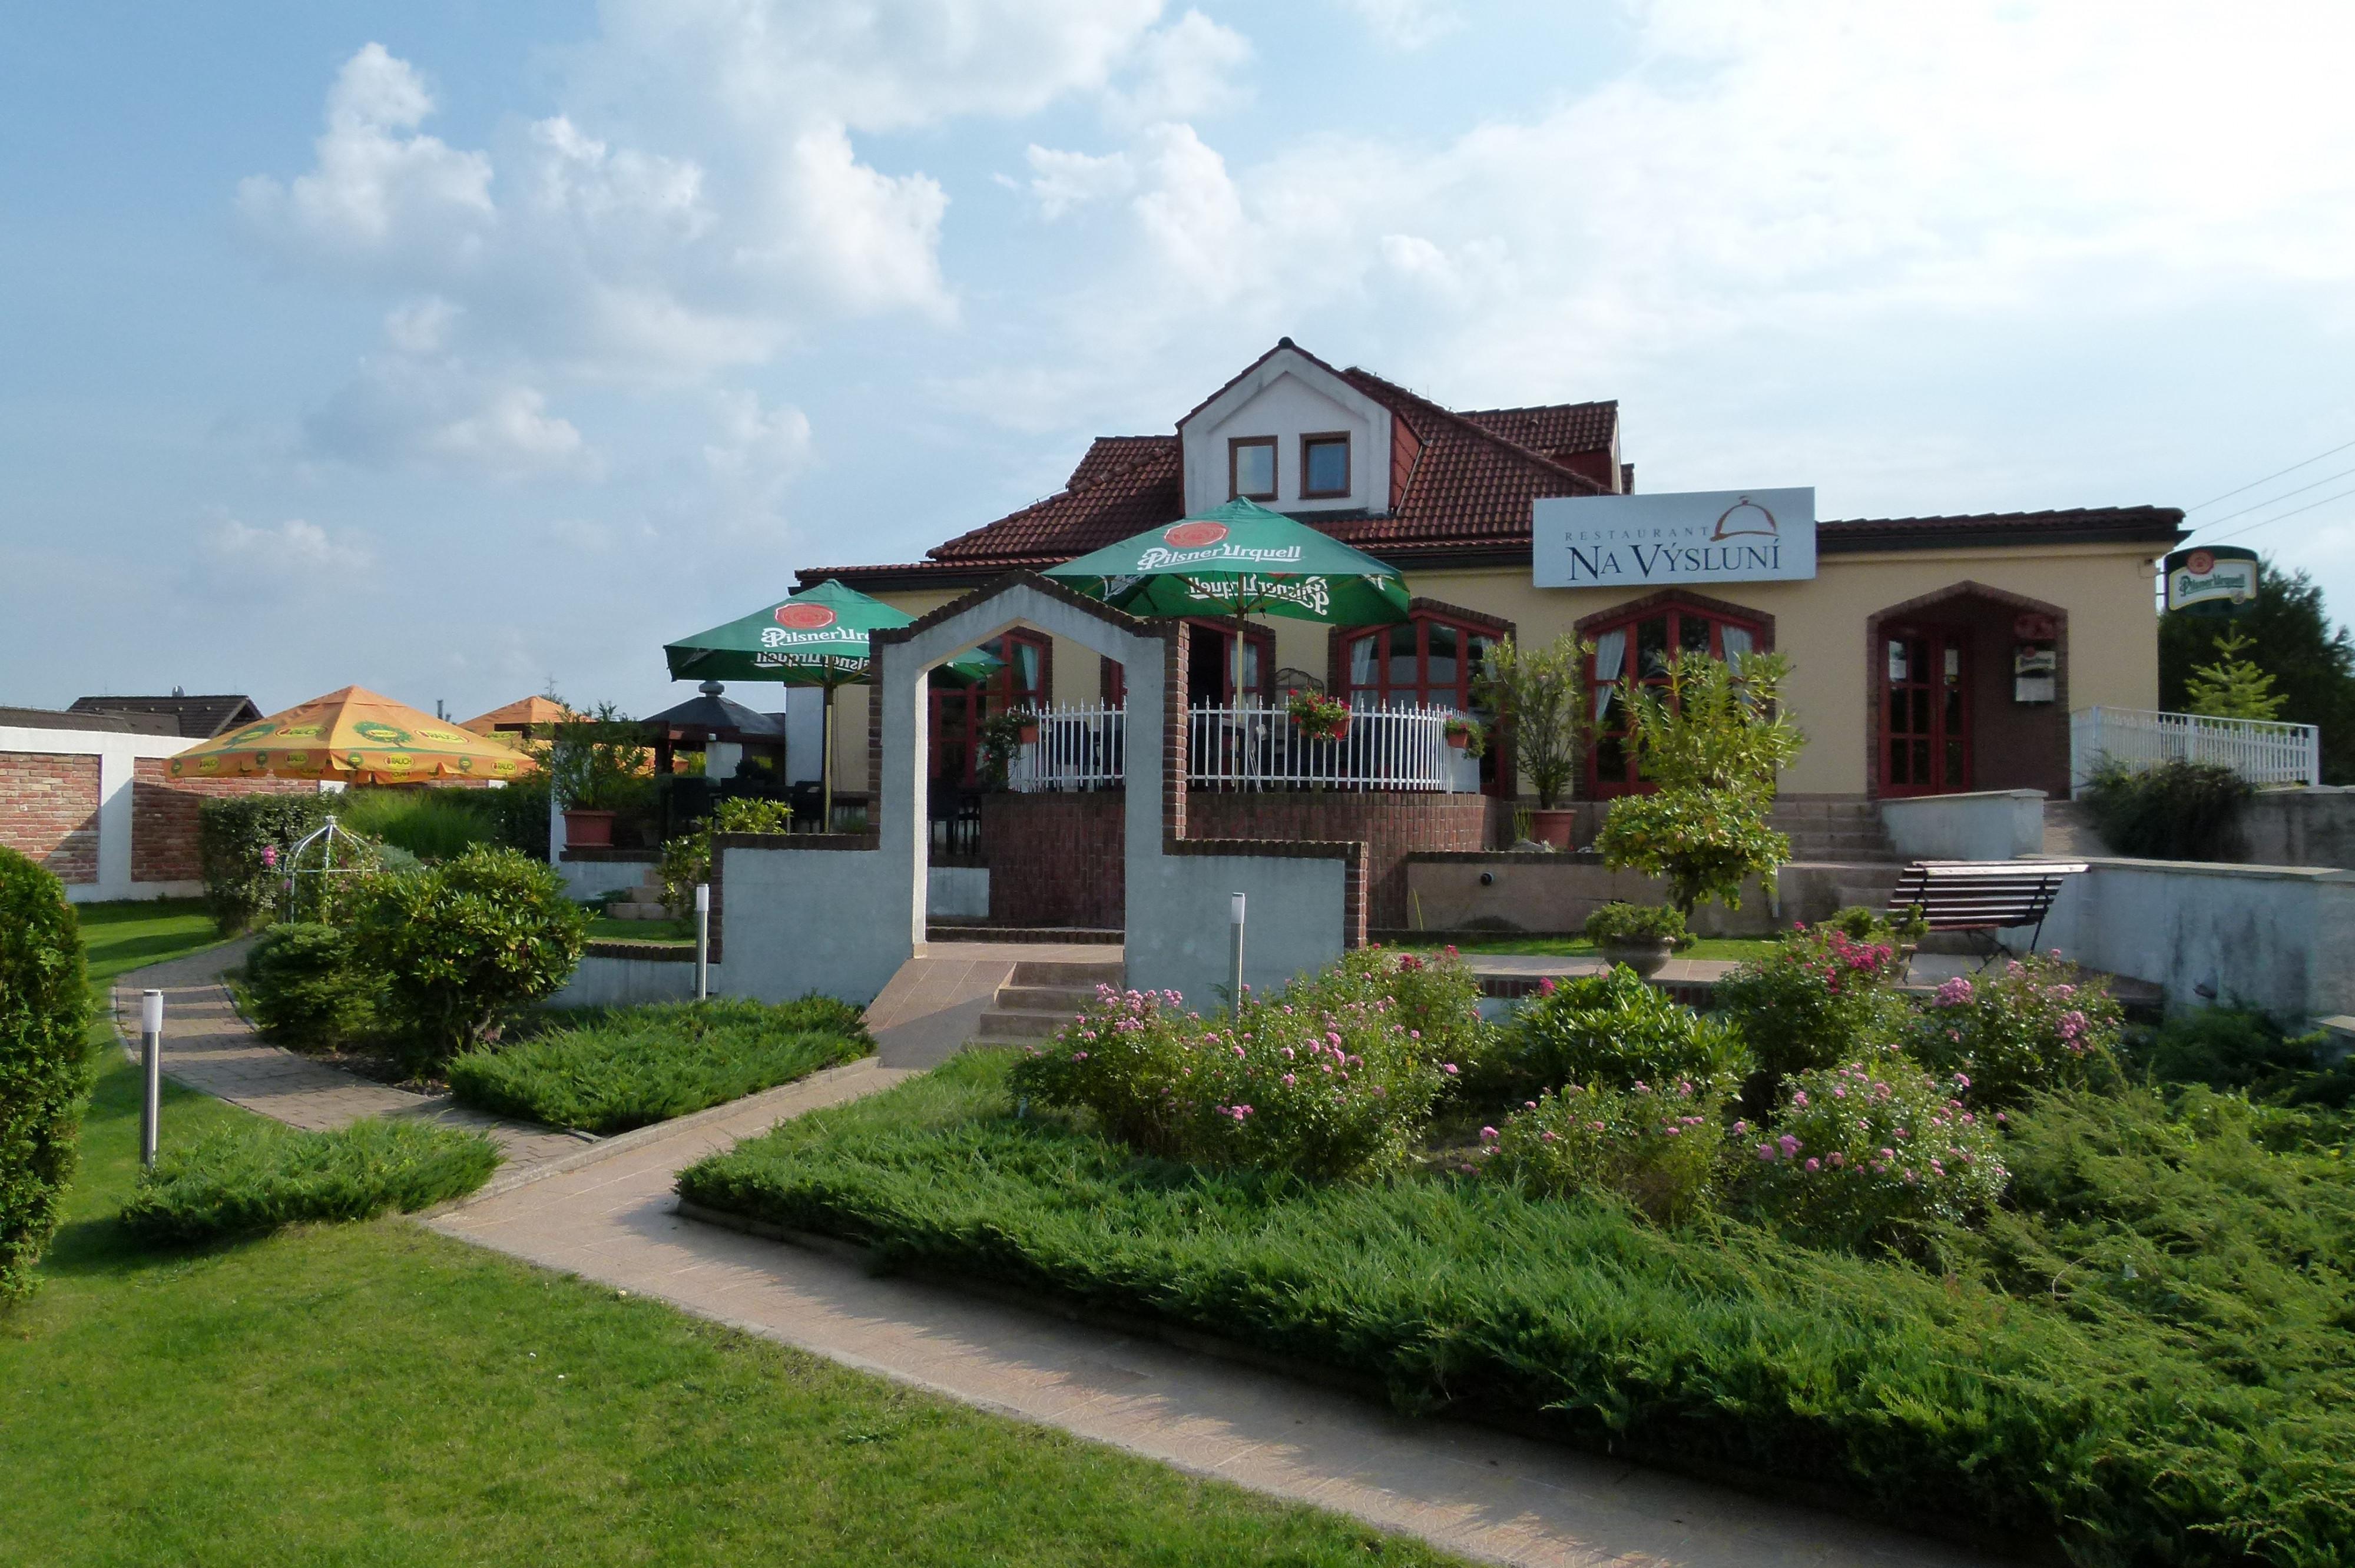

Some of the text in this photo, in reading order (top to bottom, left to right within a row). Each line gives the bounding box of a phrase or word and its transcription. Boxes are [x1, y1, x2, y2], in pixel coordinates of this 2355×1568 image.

[1565, 526, 1708, 541] RESTAURANT
[1137, 543, 1301, 571] Pilsner Urquell
[761, 627, 839, 648] Pilsner
